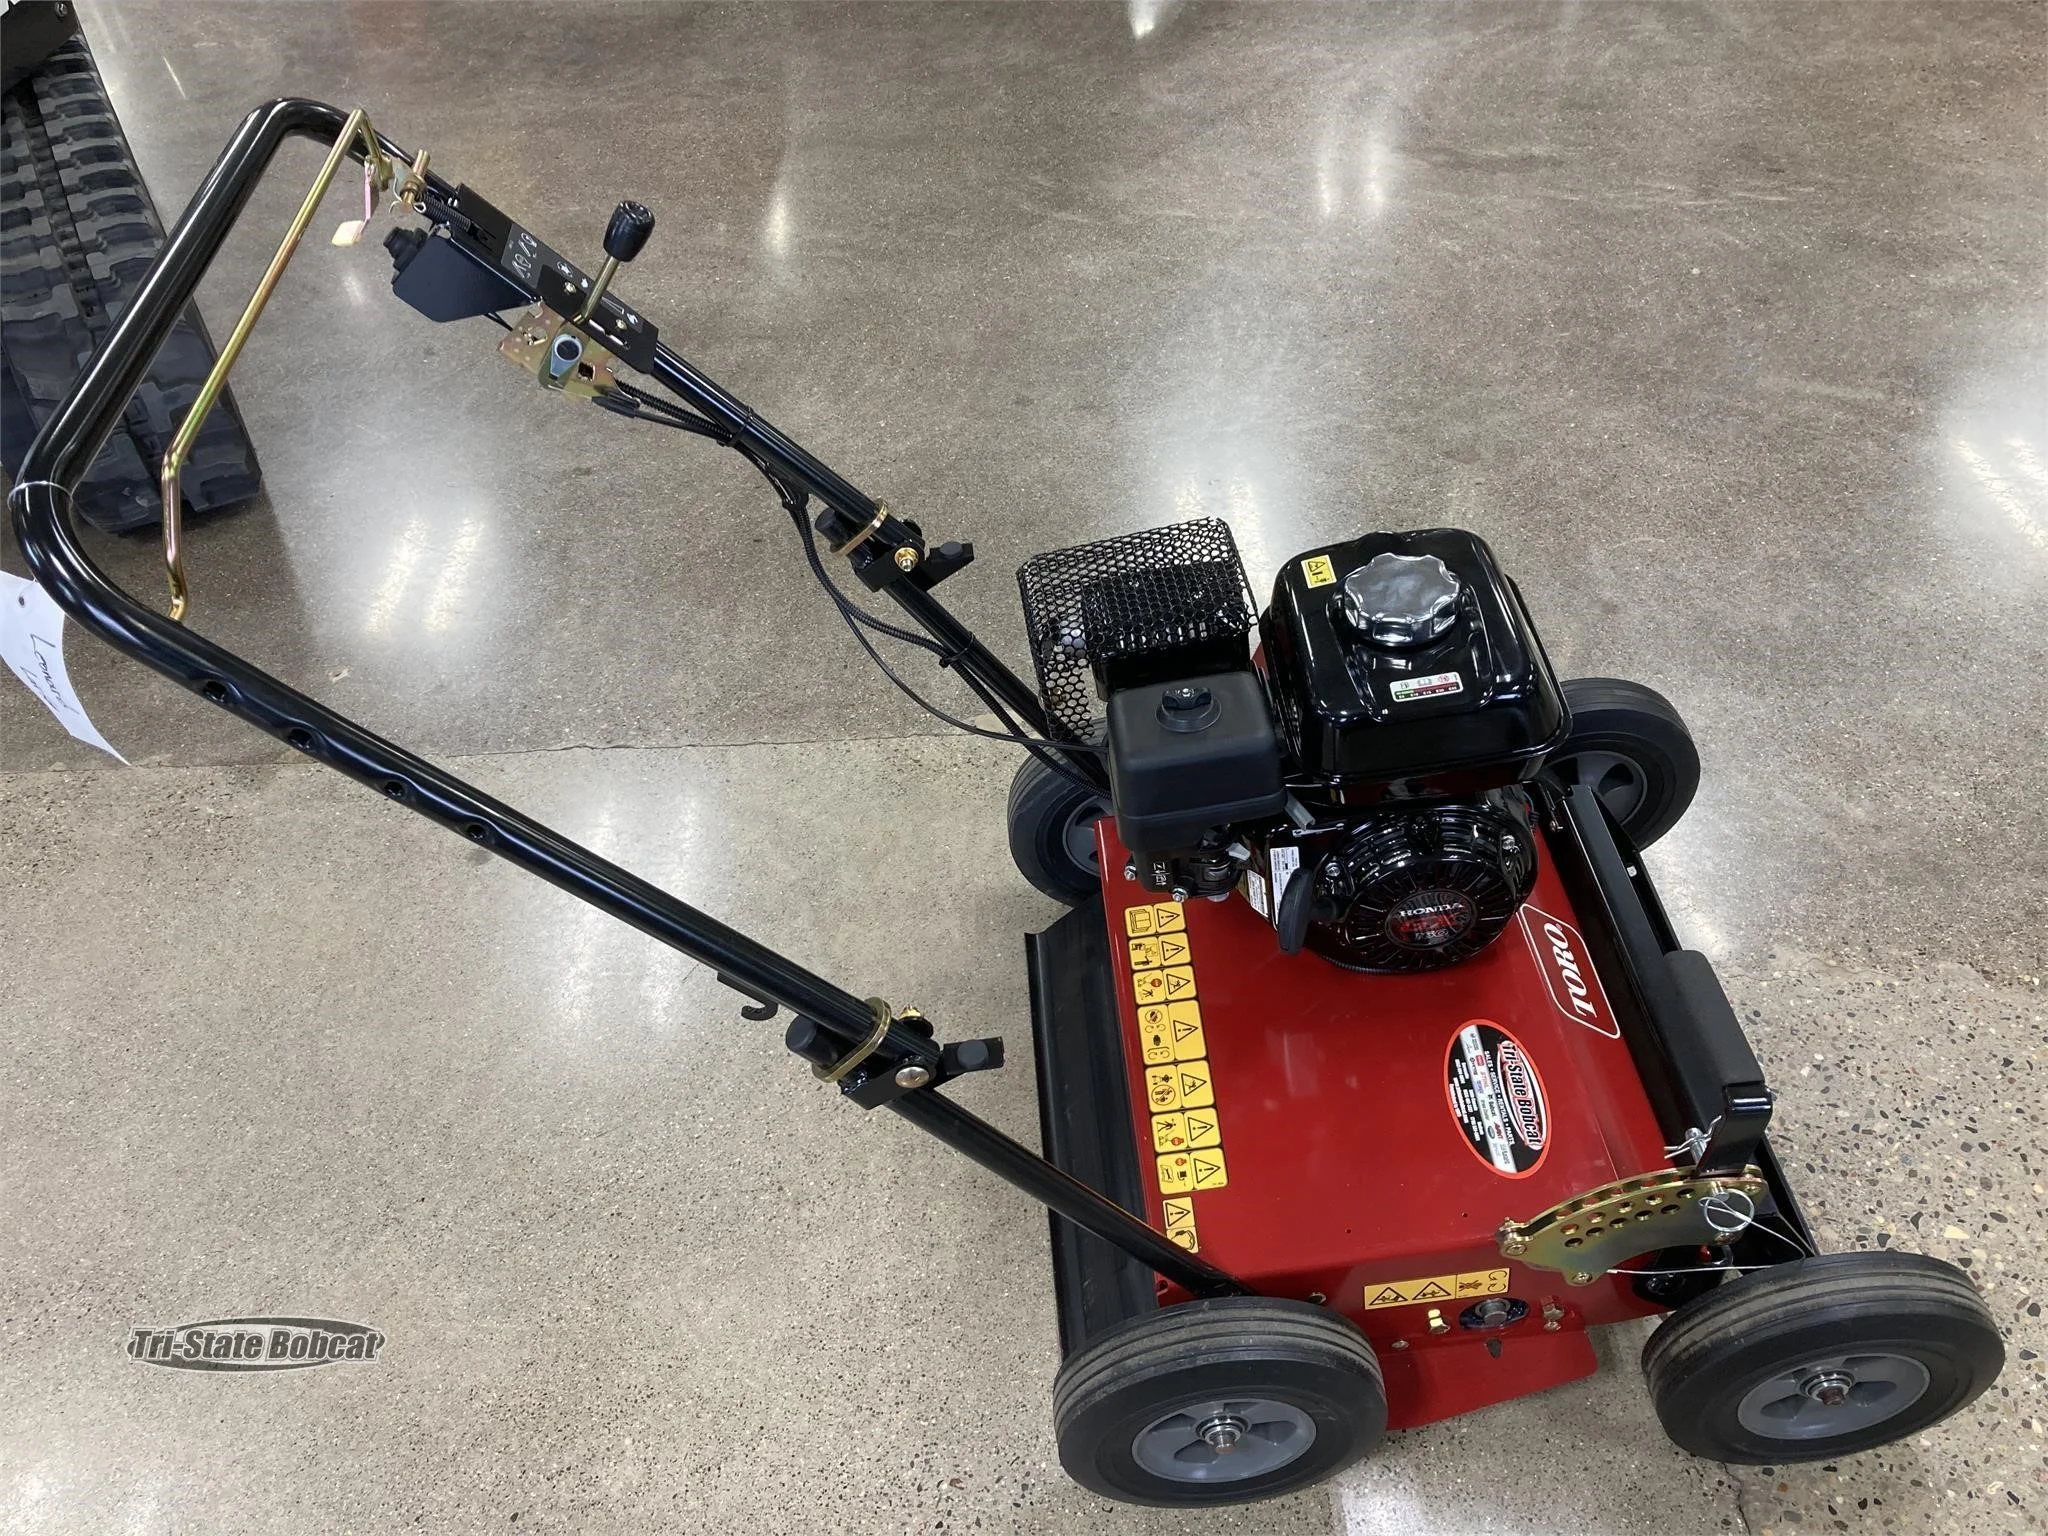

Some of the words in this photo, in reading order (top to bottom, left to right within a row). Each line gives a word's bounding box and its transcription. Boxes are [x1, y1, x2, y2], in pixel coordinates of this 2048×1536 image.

[1400, 902, 1464, 917] HONDA
[1544, 923, 1597, 1018] TORO
[1484, 1051, 1494, 1071] SALES
[1497, 1098, 1509, 1122] RENTALS
[1505, 1124, 1516, 1146] PARTS
[1502, 1045, 1528, 1097] Tri-State
[1517, 1099, 1542, 1145] Bobcat
